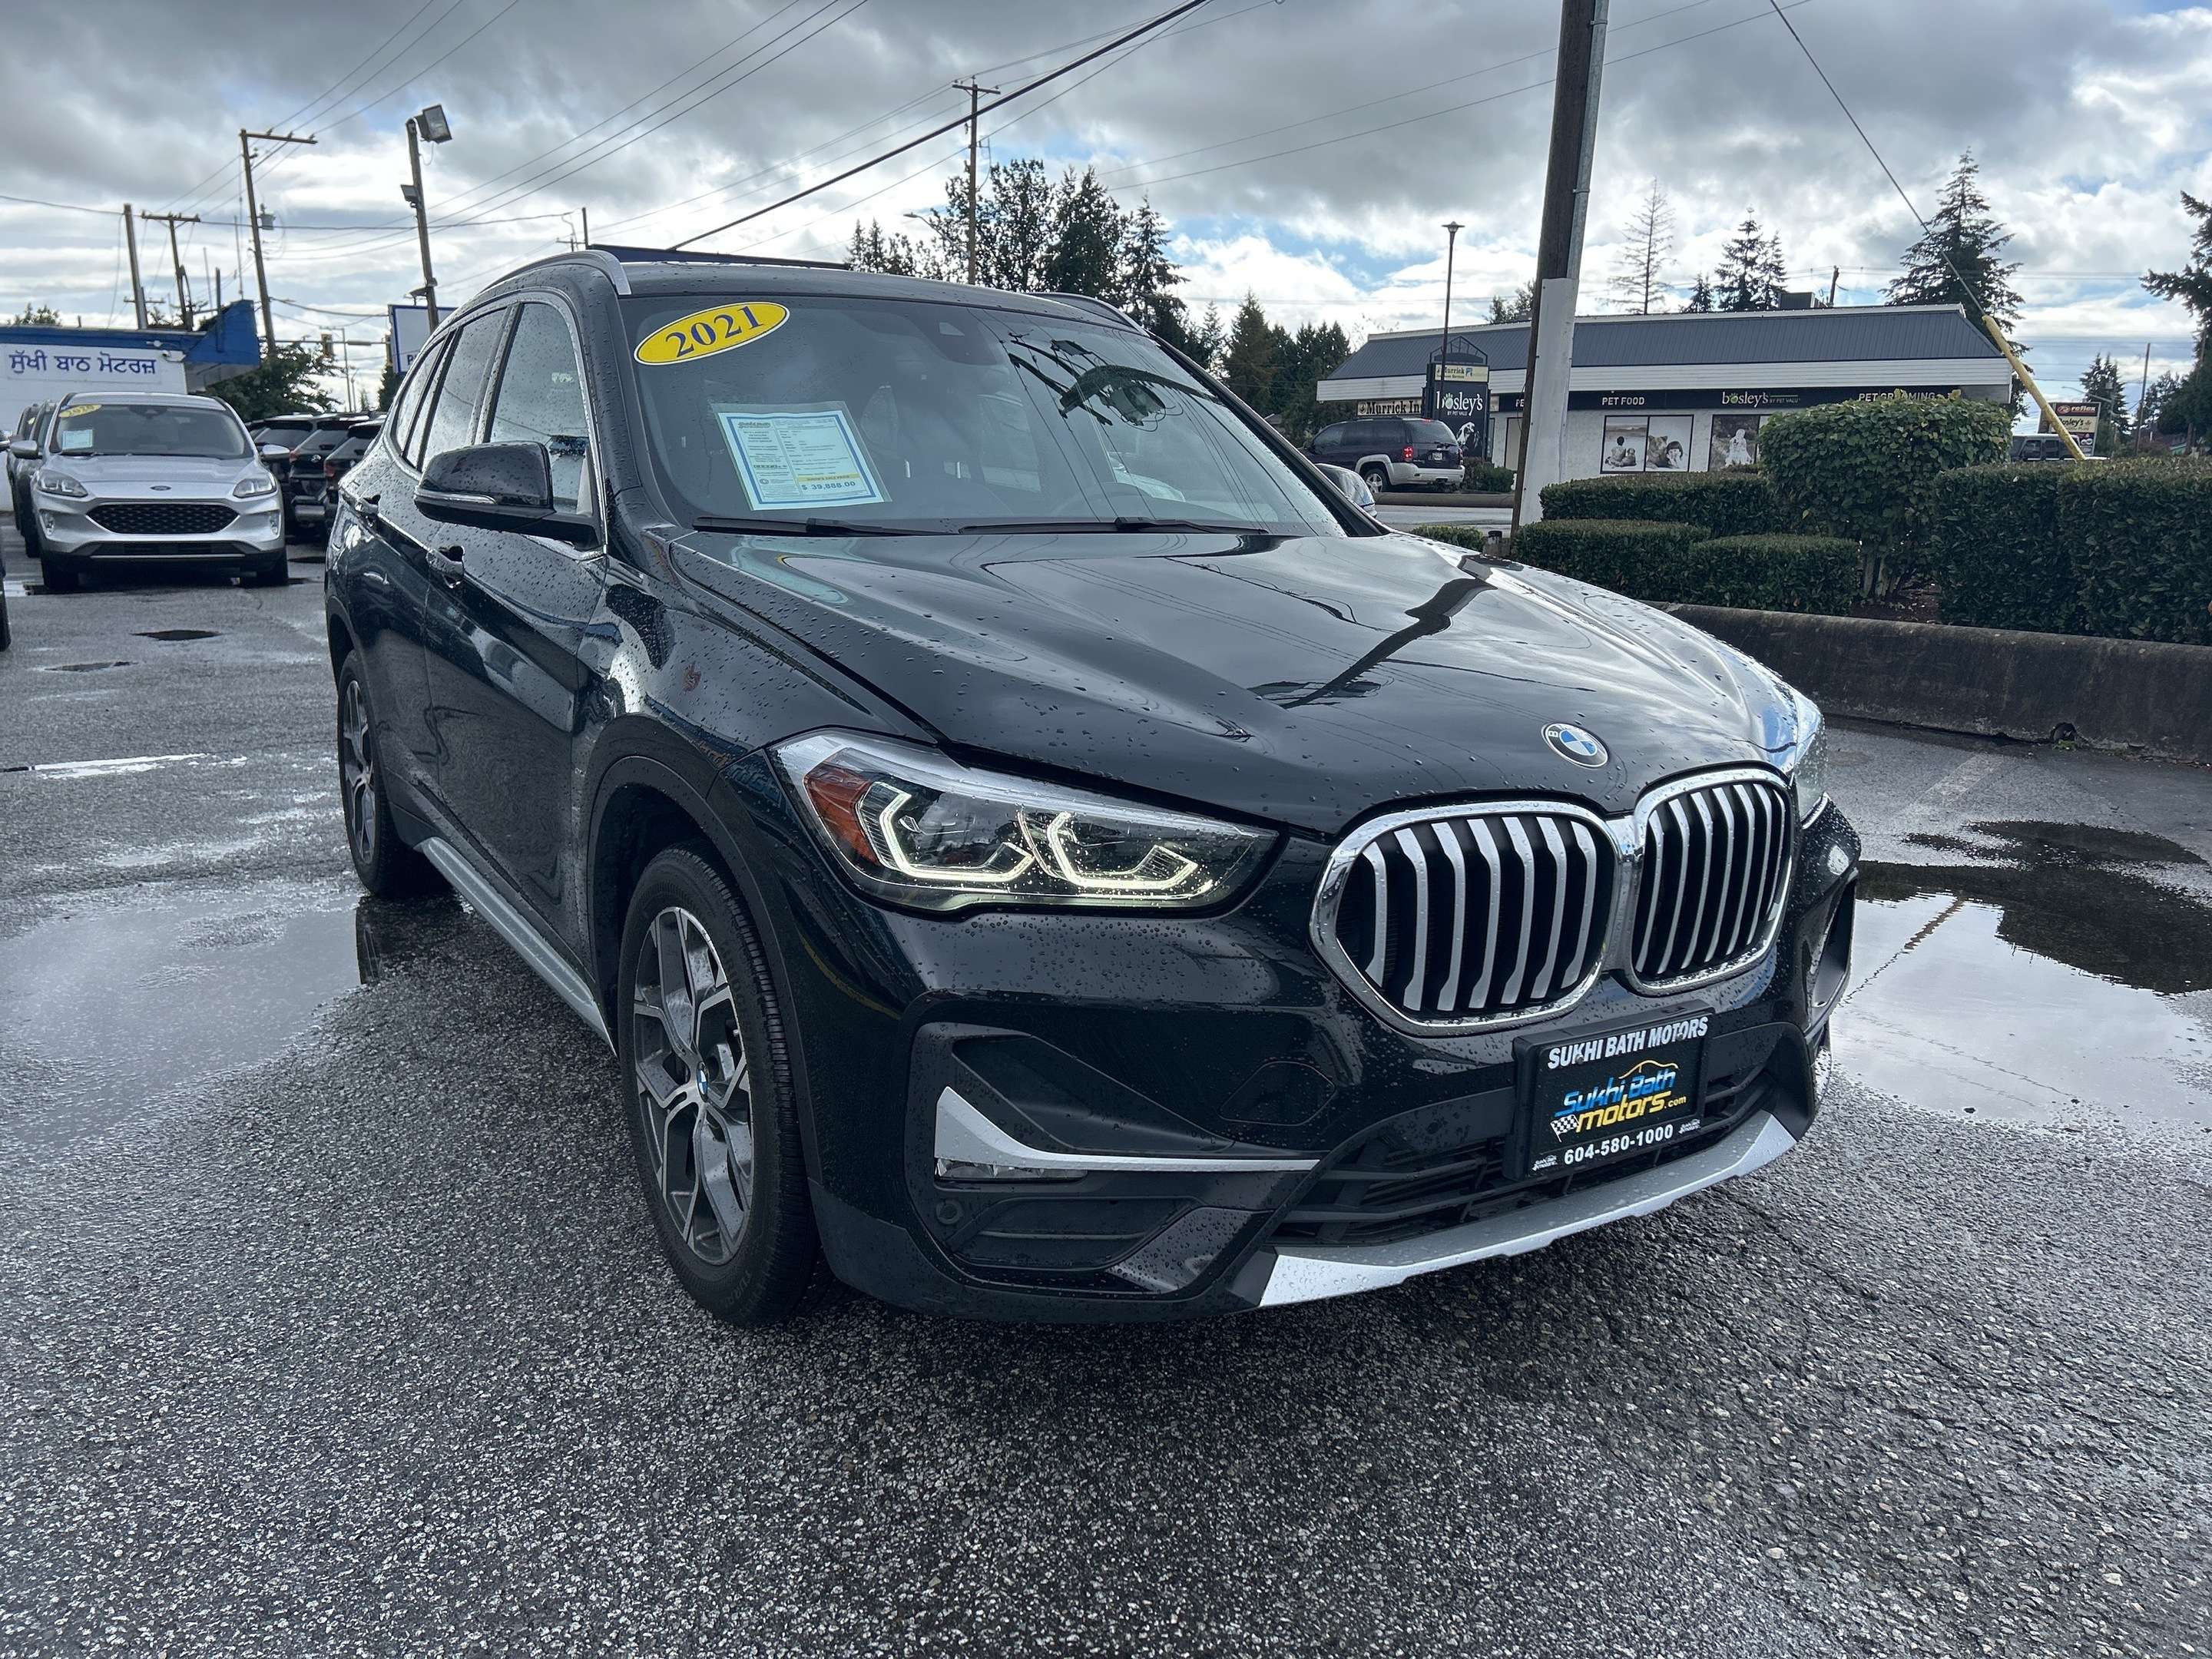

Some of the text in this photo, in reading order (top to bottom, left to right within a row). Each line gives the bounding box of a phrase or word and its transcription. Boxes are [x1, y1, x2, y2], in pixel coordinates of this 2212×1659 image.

[666, 306, 764, 358] 2021
[54, 356, 91, 372] ਬਾਠ
[1436, 391, 1483, 416] bosley's
[1602, 396, 1645, 406] PET FOOD
[1722, 392, 1769, 408] bosley's
[1859, 392, 1936, 402] PET GRMING
[1366, 400, 1407, 415] Murrick
[1548, 1016, 1708, 1069] SUKHI BATH MOTORS
[1555, 1068, 1676, 1117] Sukhi Bath
[1564, 1124, 1673, 1164] 604-580-1000
